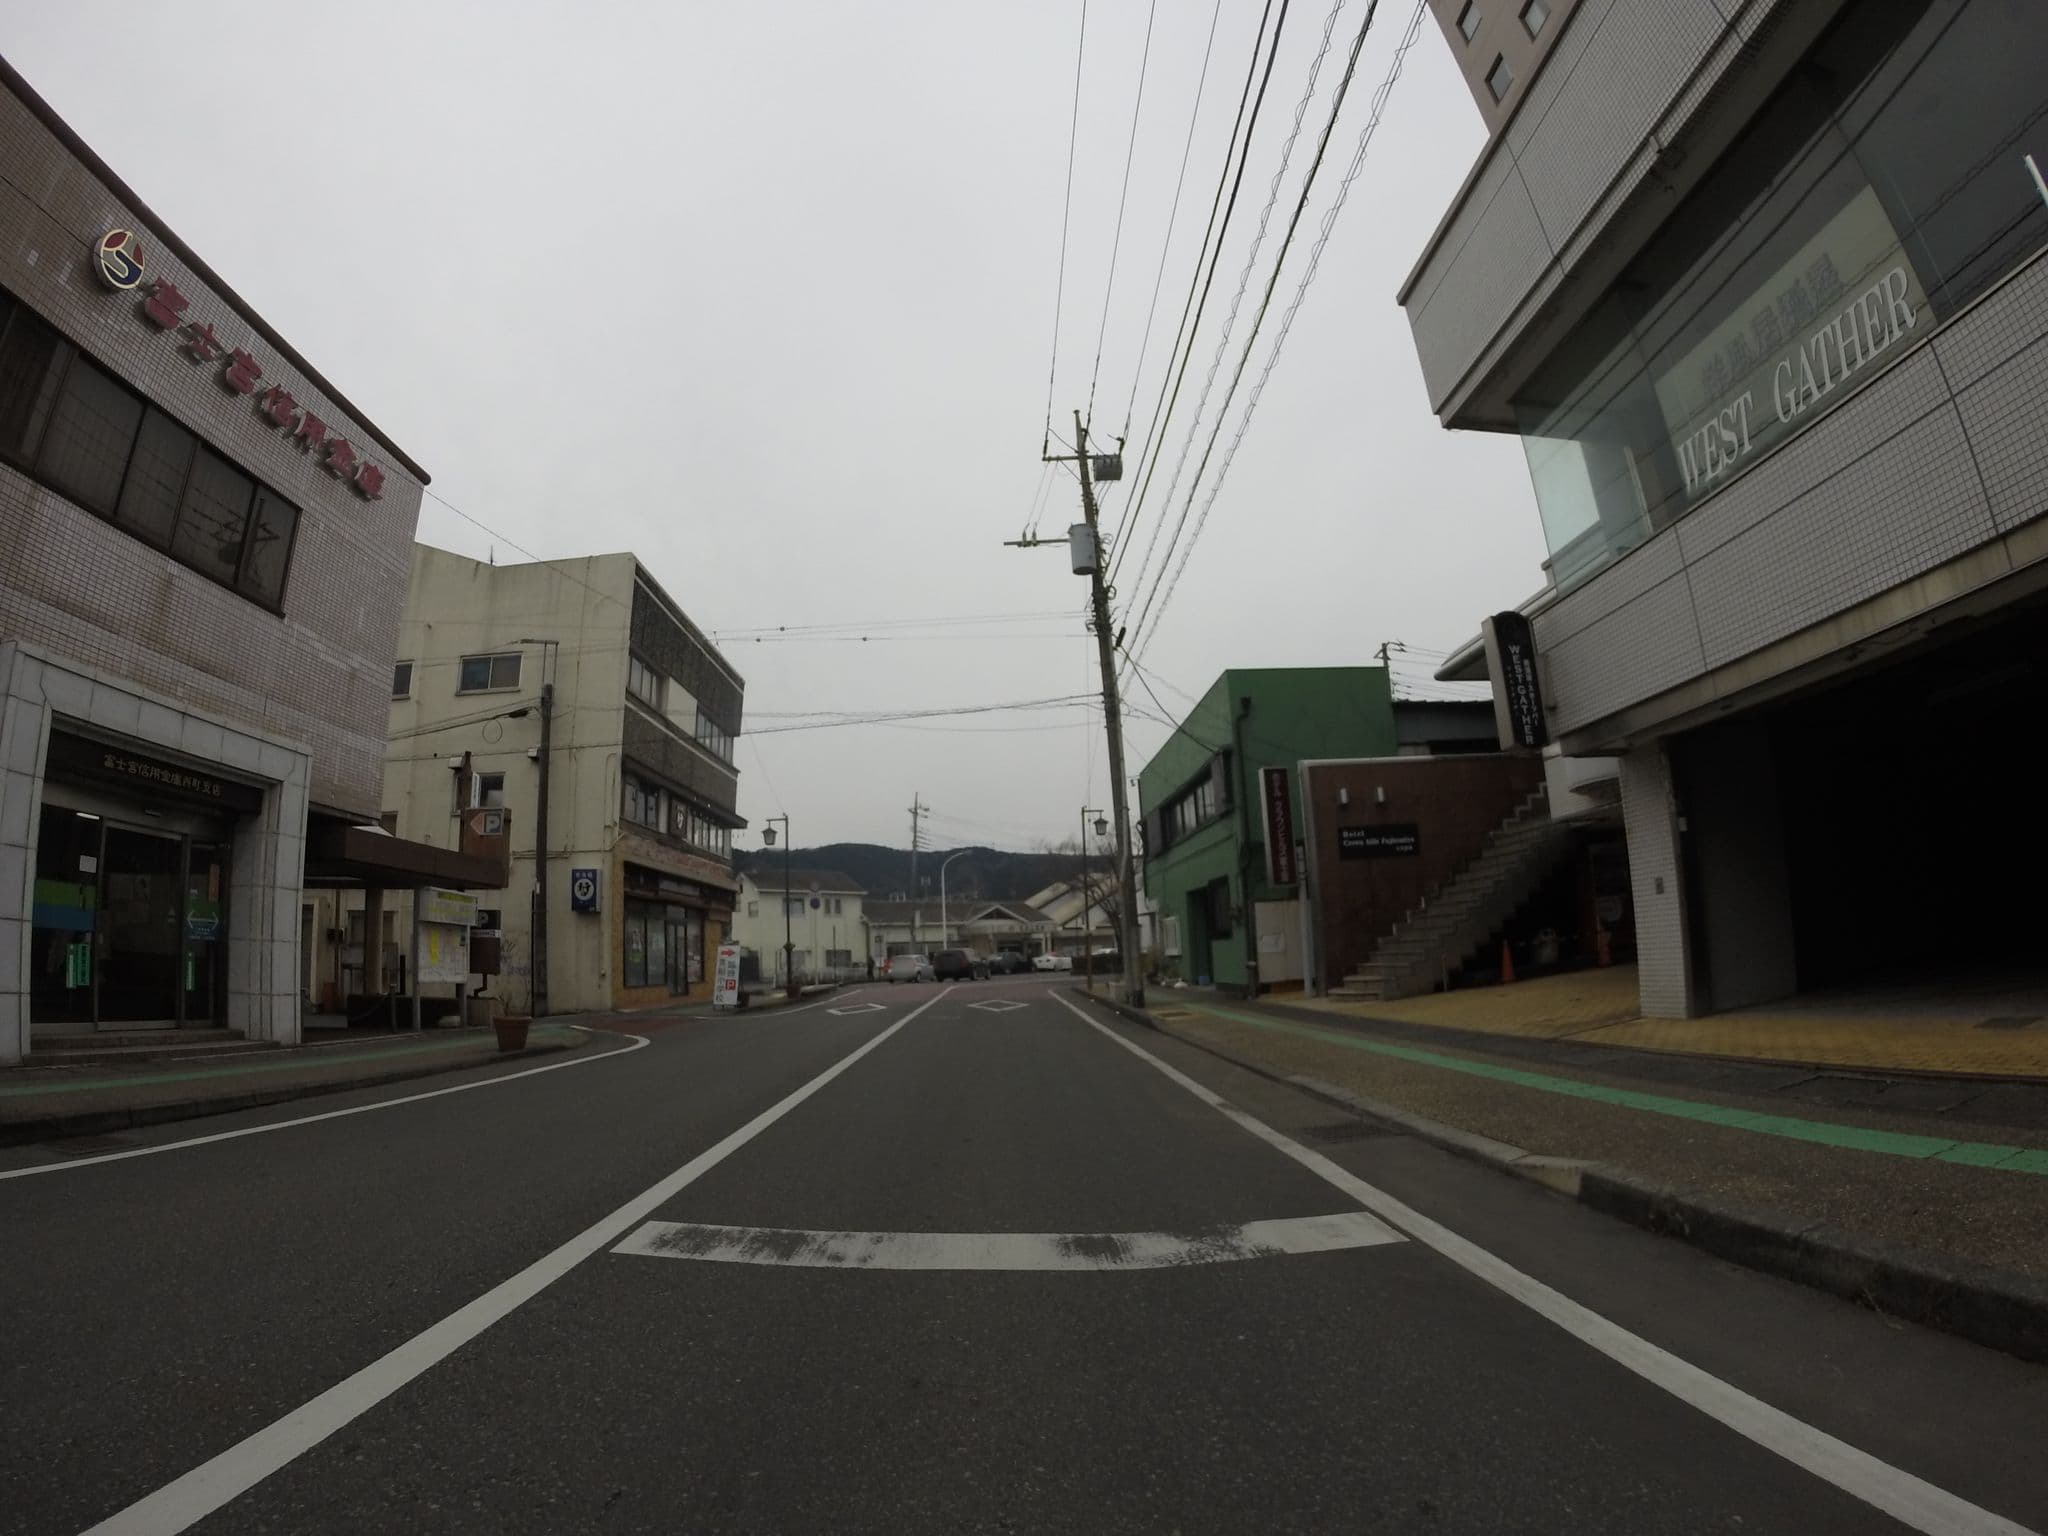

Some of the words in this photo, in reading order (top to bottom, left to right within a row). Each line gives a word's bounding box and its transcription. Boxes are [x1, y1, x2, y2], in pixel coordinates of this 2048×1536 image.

[1677, 391, 1754, 494] WEST
[1773, 266, 1917, 424] GATHER
[1508, 644, 1523, 684] WEST
[1517, 685, 1534, 745] GATHER
